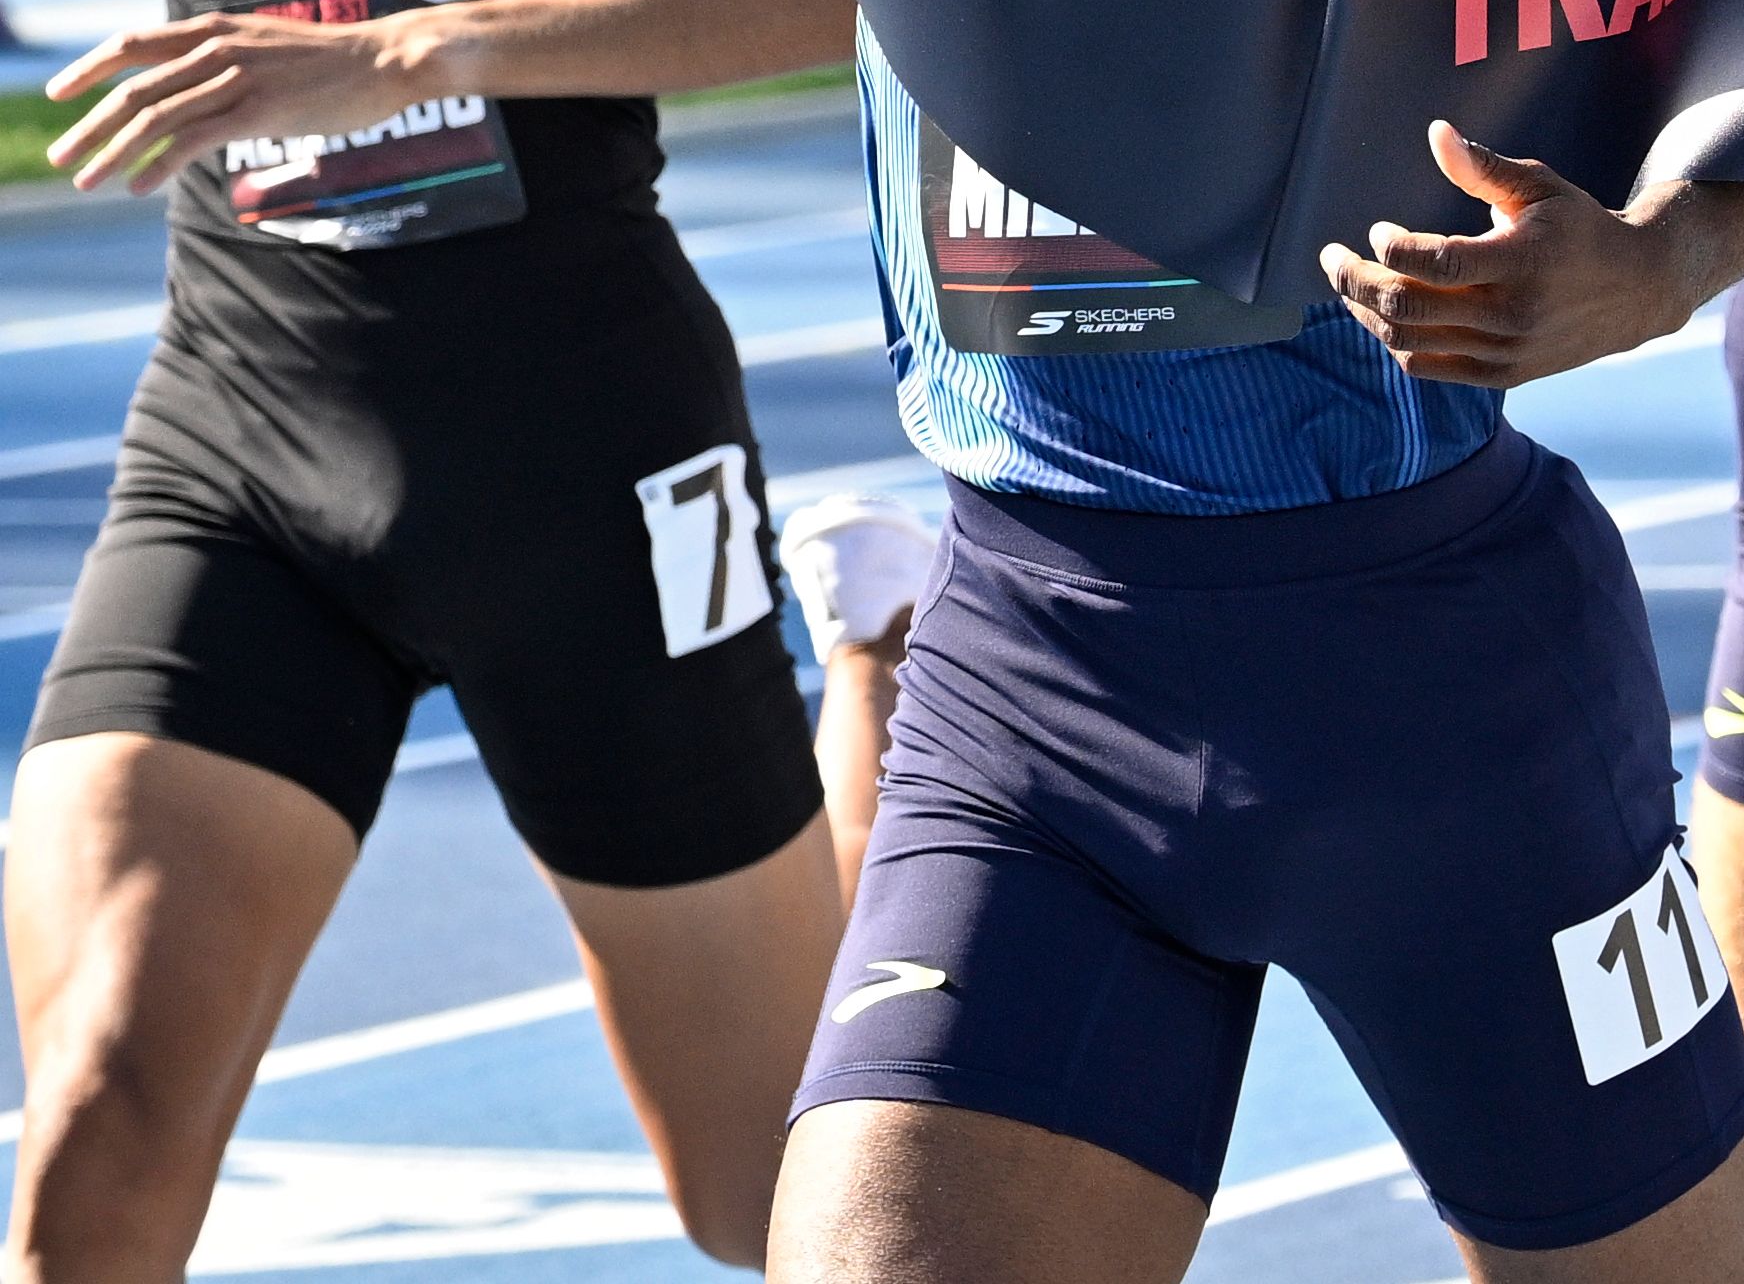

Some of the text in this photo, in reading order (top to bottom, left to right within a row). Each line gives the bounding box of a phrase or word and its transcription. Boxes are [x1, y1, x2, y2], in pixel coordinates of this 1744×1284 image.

[1074, 306, 1175, 323] SKECHERS
[1076, 321, 1144, 334] RUNNING
[670, 462, 730, 631] 7
[1597, 868, 1709, 1049] 11
